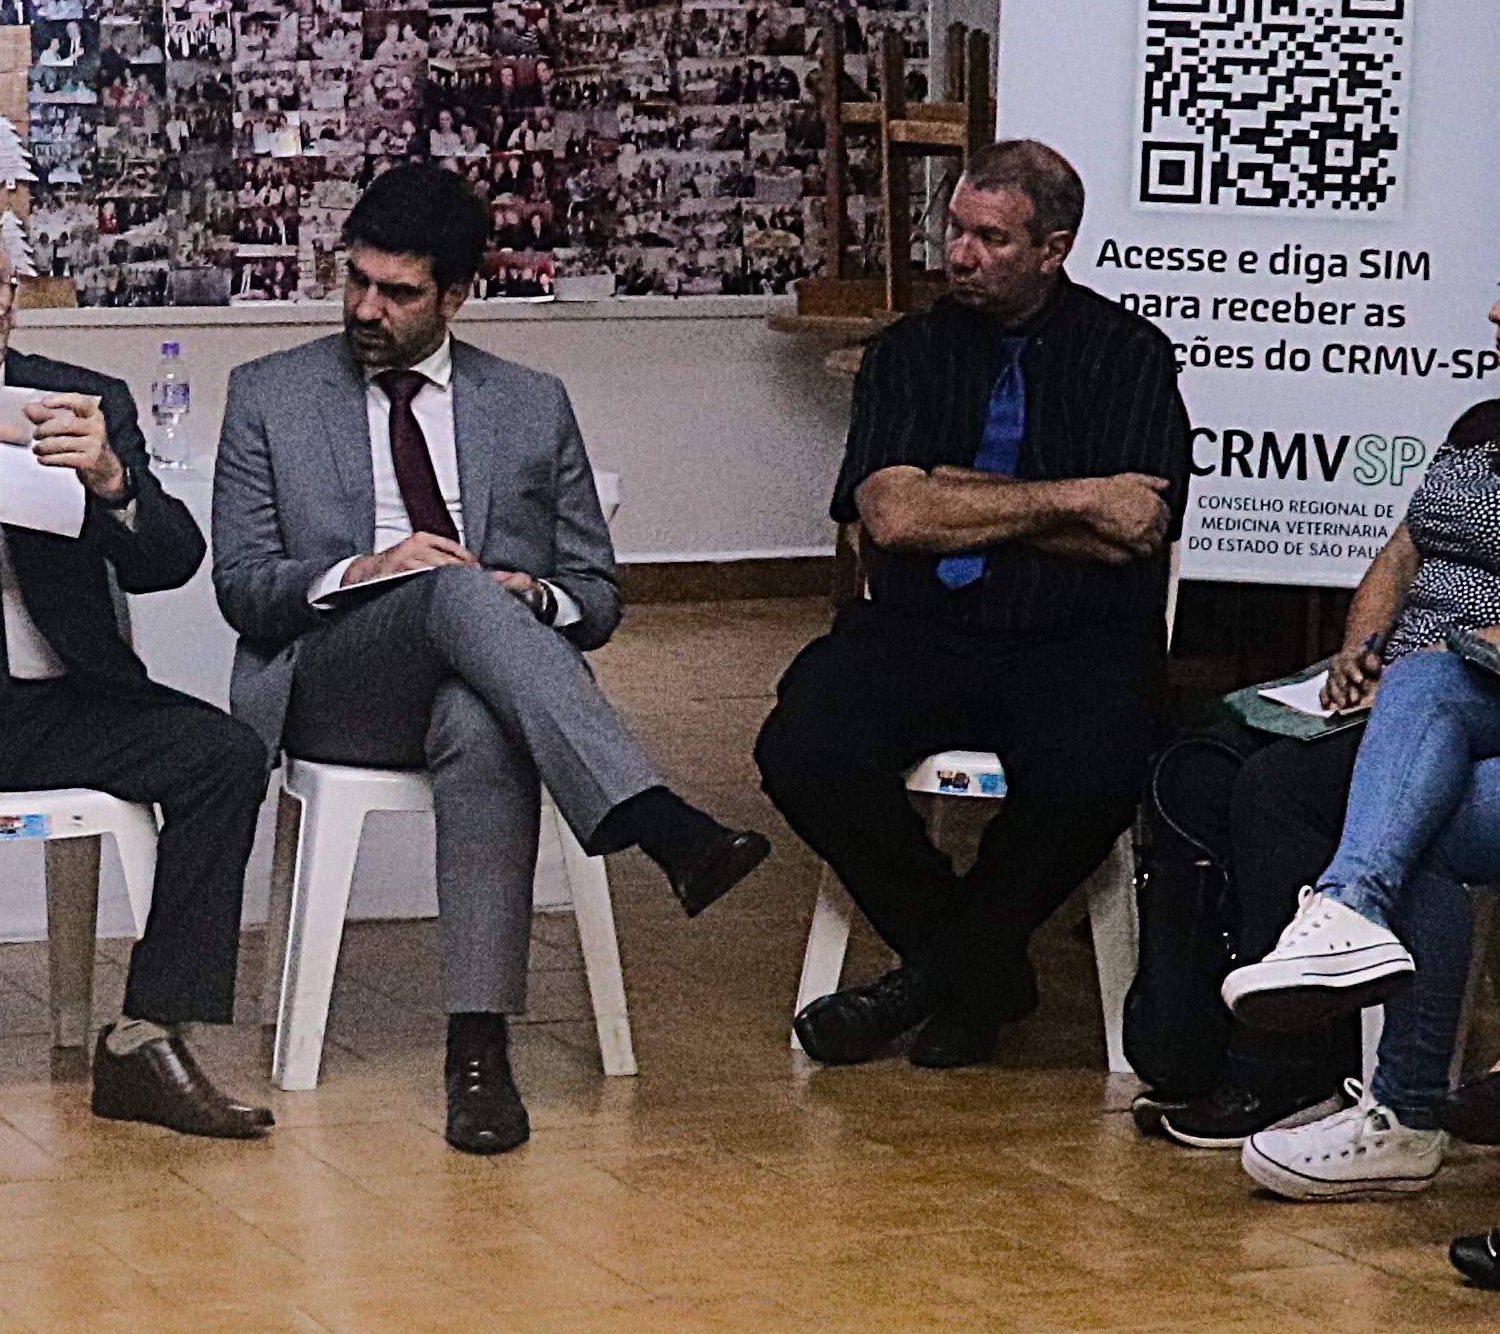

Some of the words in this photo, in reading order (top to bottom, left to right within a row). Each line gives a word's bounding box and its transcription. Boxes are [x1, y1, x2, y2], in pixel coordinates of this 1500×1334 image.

[1095, 238, 1227, 273] Acesse
[1237, 249, 1259, 274] e
[1268, 243, 1349, 285] diga
[1359, 248, 1431, 283] SIM
[1211, 292, 1356, 327] receber
[1363, 301, 1406, 329] as
[1264, 339, 1311, 373] do
[1321, 342, 1498, 381] CRMV-SP
[1198, 495, 1283, 513] CONSELHO
[1289, 500, 1369, 517] REGIONAL
[1374, 504, 1395, 518] DE
[1200, 517, 1281, 534] MEDICINA
[1286, 519, 1389, 539] VETERINÁRIA
[1188, 536, 1212, 551] DO
[1217, 537, 1279, 555] ESTADO
[1284, 542, 1304, 556] DE
[1309, 540, 1342, 558] SÃO
